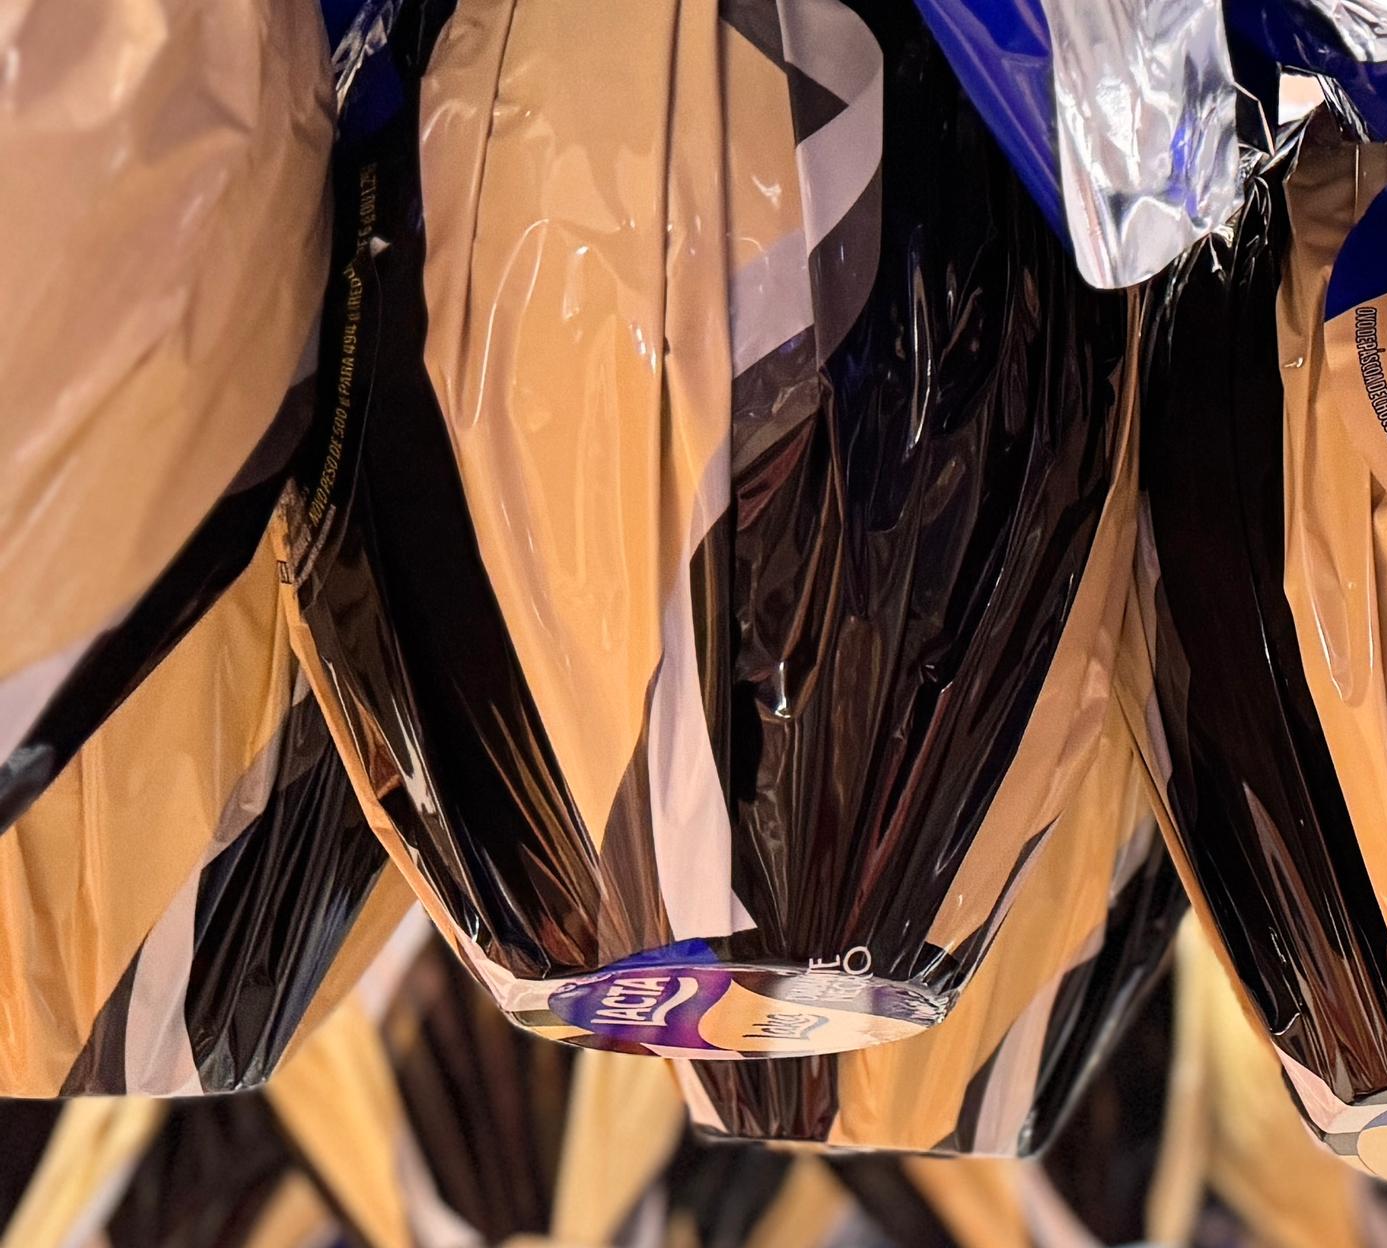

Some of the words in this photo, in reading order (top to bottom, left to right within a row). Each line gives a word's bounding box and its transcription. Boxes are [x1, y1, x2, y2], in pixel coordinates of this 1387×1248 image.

[1356, 307, 1377, 328] OVO
[1356, 328, 1377, 343] DE
[590, 976, 690, 1026] LACTA
